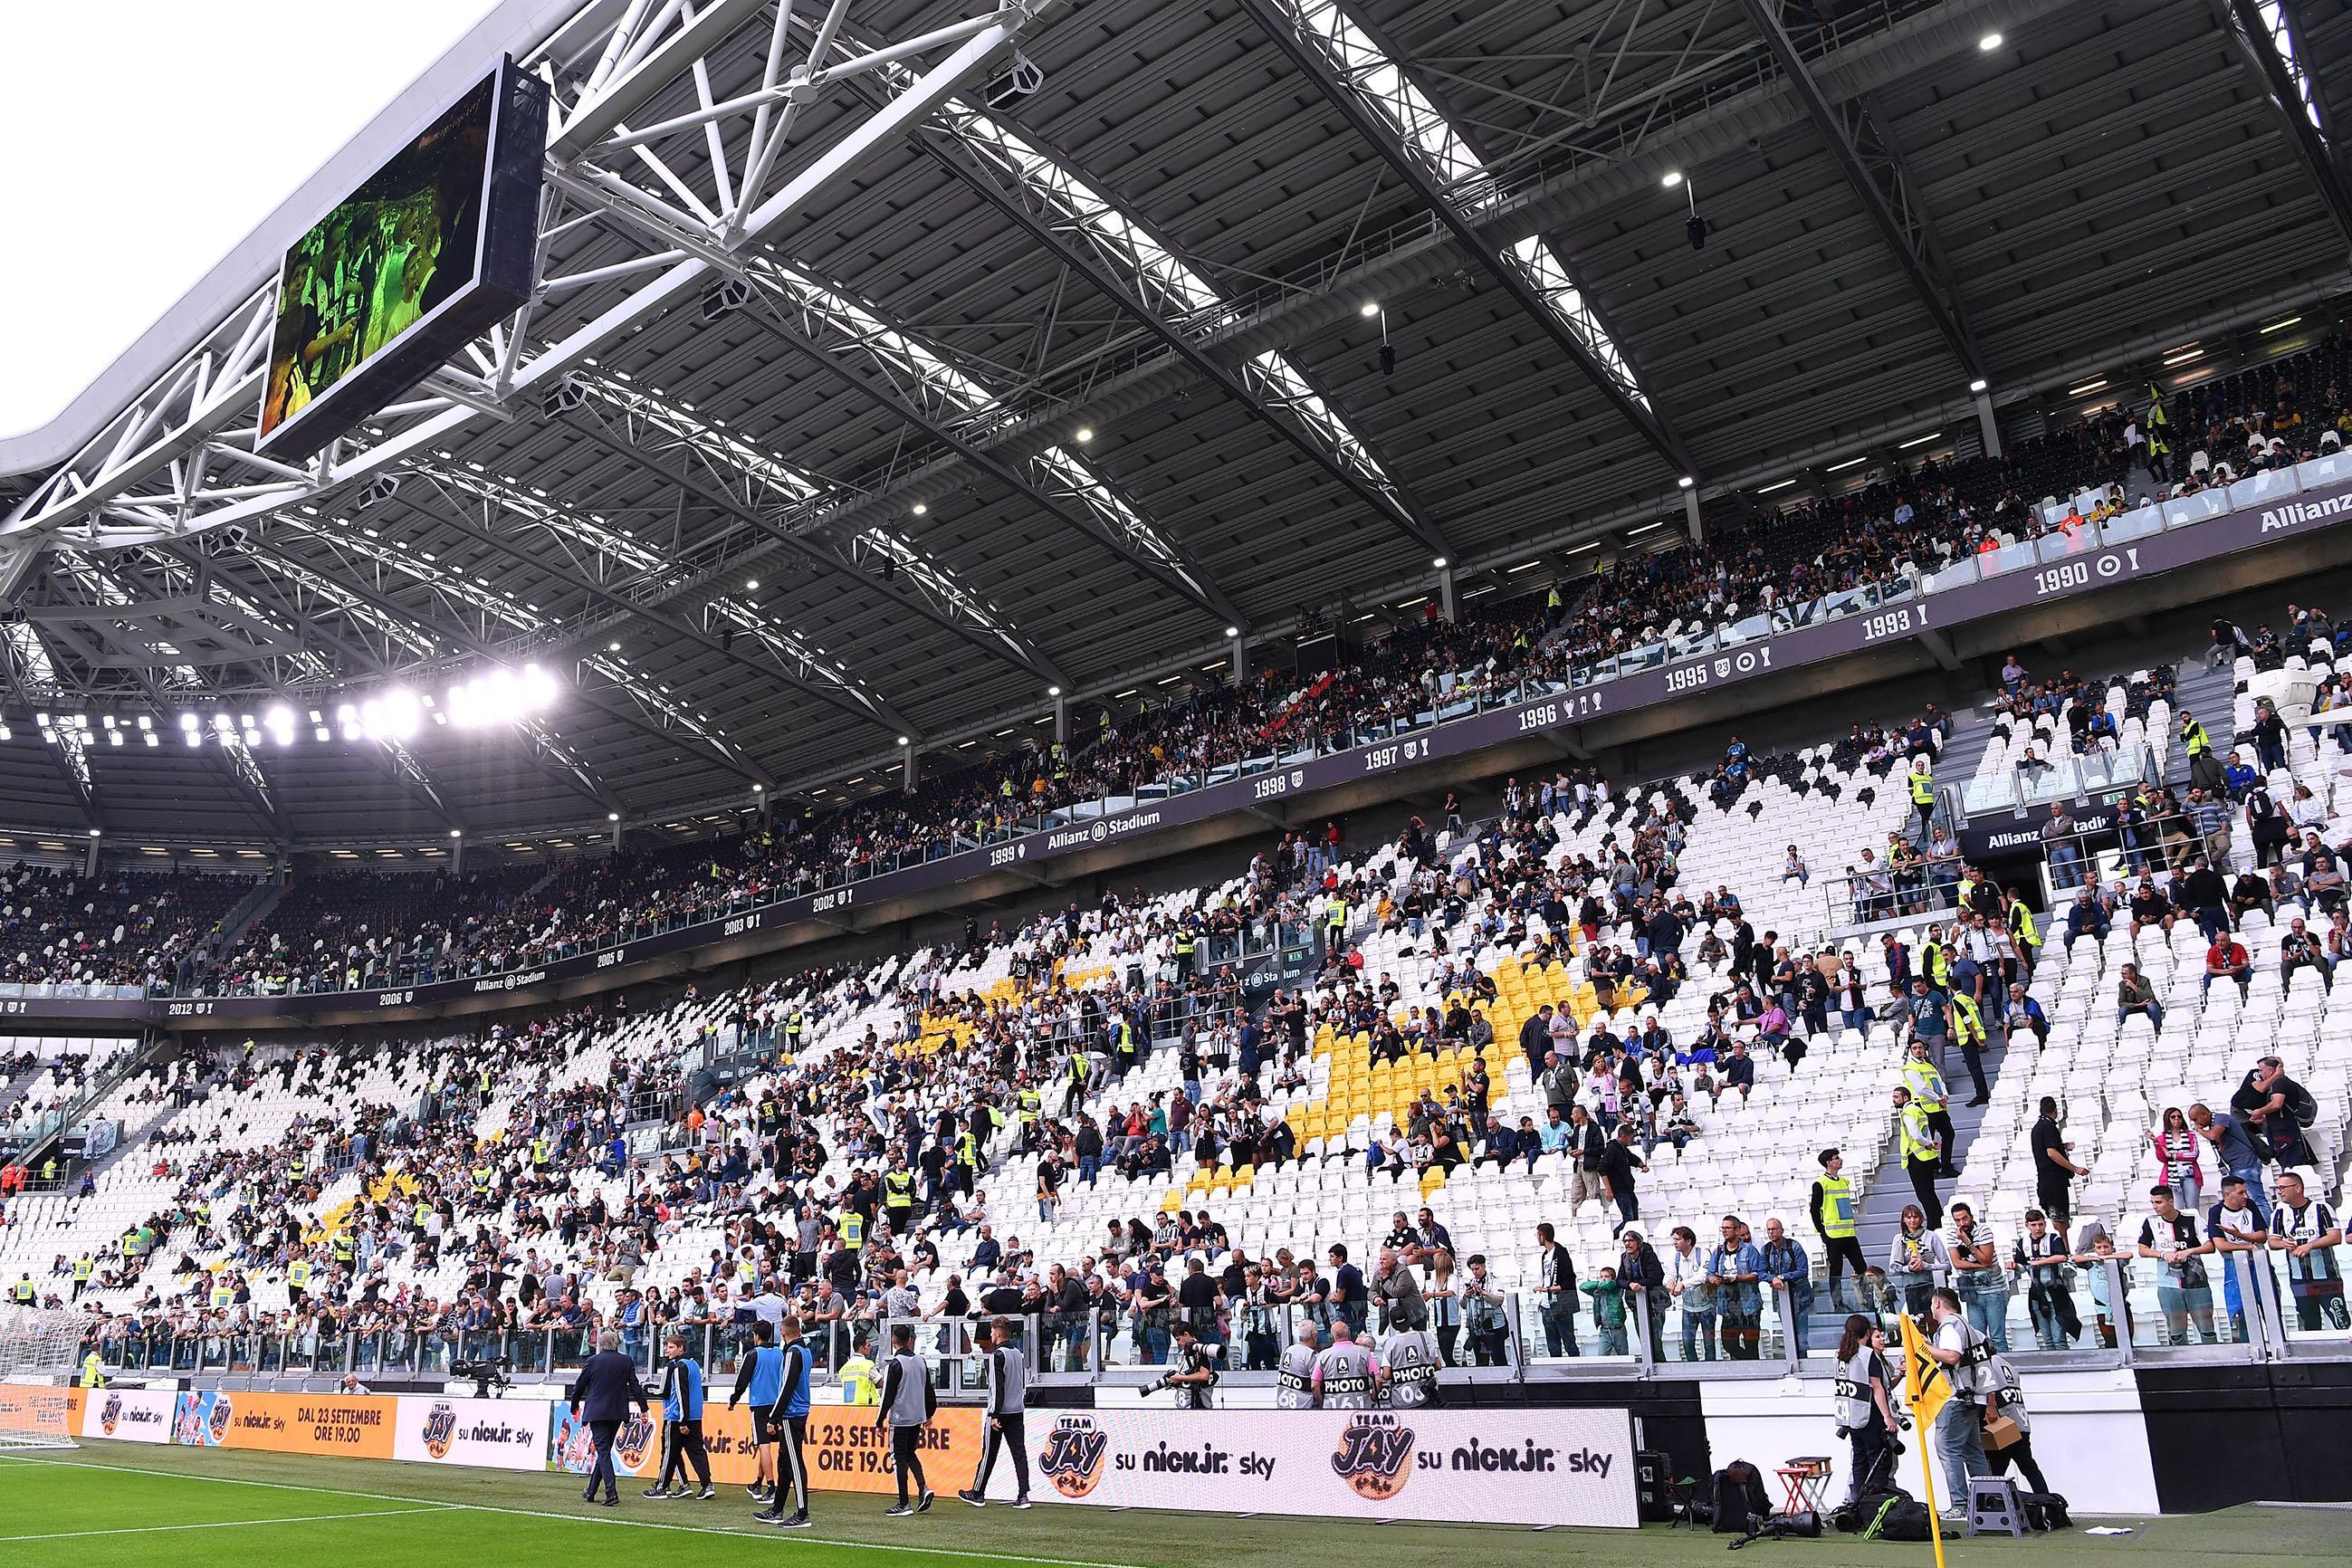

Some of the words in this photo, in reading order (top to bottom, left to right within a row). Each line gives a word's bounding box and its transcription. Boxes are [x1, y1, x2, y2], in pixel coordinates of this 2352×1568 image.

[2261, 493, 2352, 532] Allianz
[2034, 562, 2089, 595] 1990
[1862, 609, 1910, 641] 1993
[1665, 664, 1708, 693] 1995
[1716, 662, 1729, 674] 23
[1518, 703, 1557, 731] 1996
[1365, 746, 1399, 770] 1997
[1254, 776, 1286, 798] 1998
[1047, 829, 1089, 850] Allianz
[1109, 812, 1160, 835] Stadium
[1988, 831, 2040, 849] Allianz
[990, 846, 1015, 866] 1999
[813, 894, 835, 913] 2002
[724, 918, 744, 936] 2003
[597, 952, 615, 968] 2005
[474, 979, 503, 991] Allianz
[516, 971, 546, 987] Stadium
[169, 1004, 193, 1015] 2012
[379, 993, 402, 1006] 2006
[2161, 1238, 2187, 1249] Jeep
[1324, 1379, 1365, 1392] PHOTO
[153, 1412, 163, 1425] sky
[210, 1404, 231, 1429] JAY
[273, 1417, 286, 1432] sky
[298, 1408, 315, 1422] DAL
[318, 1409, 329, 1423] 23
[331, 1409, 381, 1425] SETTEMBRE
[1059, 1419, 1092, 1429] TEAM
[1356, 1414, 1394, 1426] TEAM
[314, 1426, 332, 1440] ORE
[335, 1427, 360, 1443] 19.00
[423, 1412, 456, 1442] JAY
[616, 1421, 654, 1451] JAY
[822, 1425, 844, 1446] 23
[516, 1428, 533, 1448] sky
[818, 1449, 853, 1471] ORE
[1040, 1430, 1107, 1477] JAY
[1333, 1428, 1414, 1476] JAY
[1240, 1451, 1276, 1481] sky
[1569, 1448, 1612, 1478] sky
